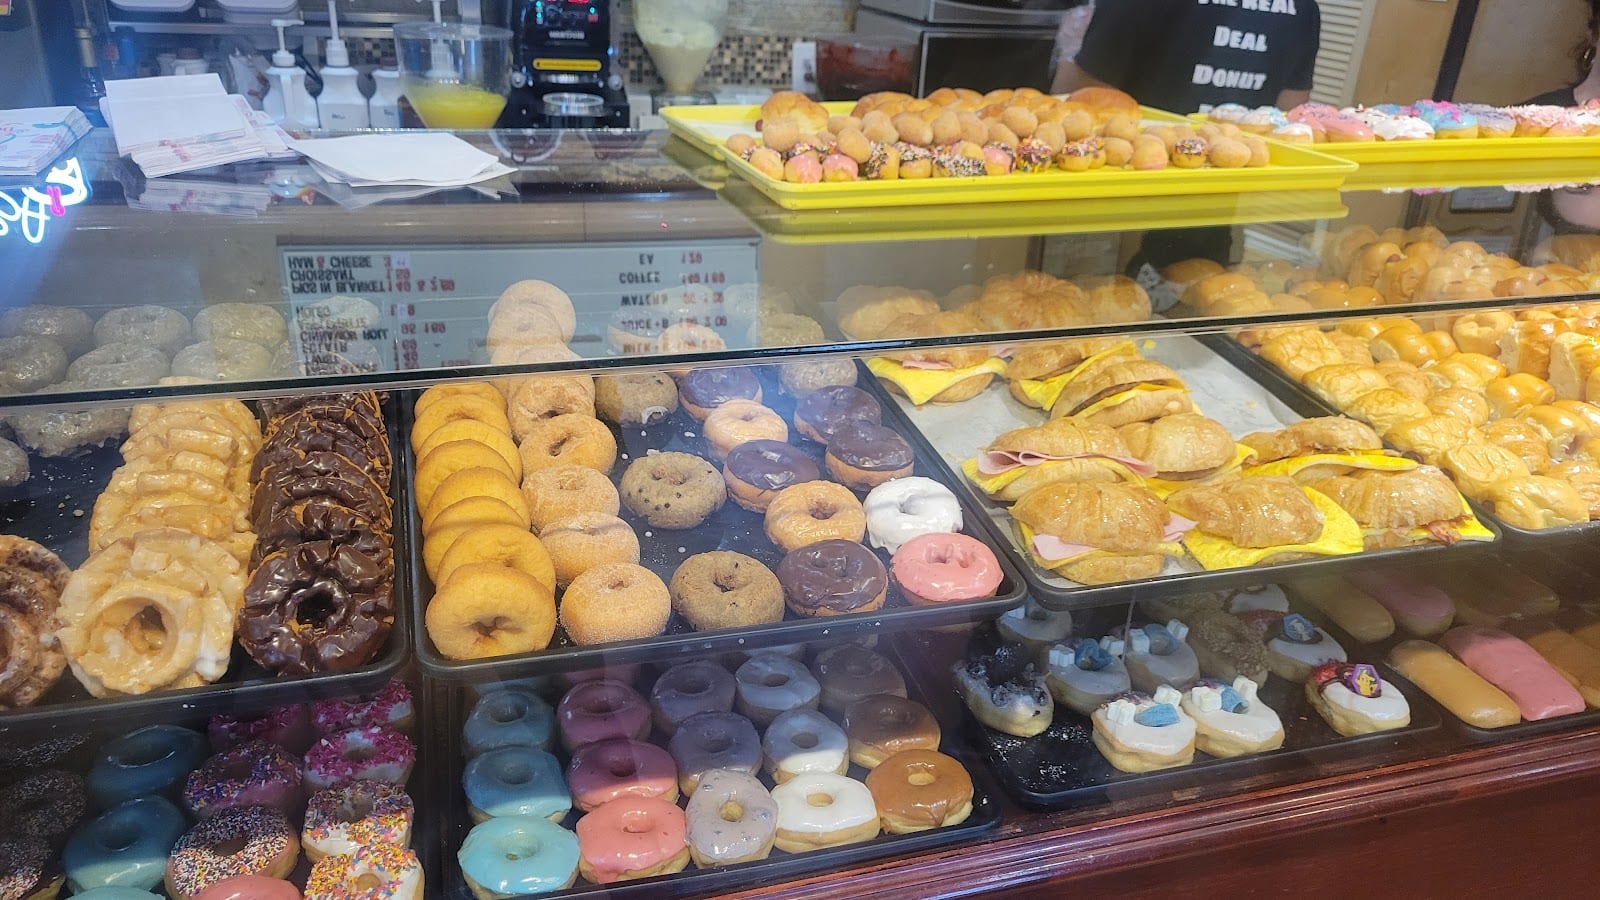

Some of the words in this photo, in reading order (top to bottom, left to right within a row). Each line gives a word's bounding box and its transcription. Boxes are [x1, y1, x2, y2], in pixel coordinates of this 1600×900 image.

[1241, 0, 1297, 15] REAL
[1213, 25, 1268, 52] DEAL
[1191, 64, 1267, 91] DONUT
